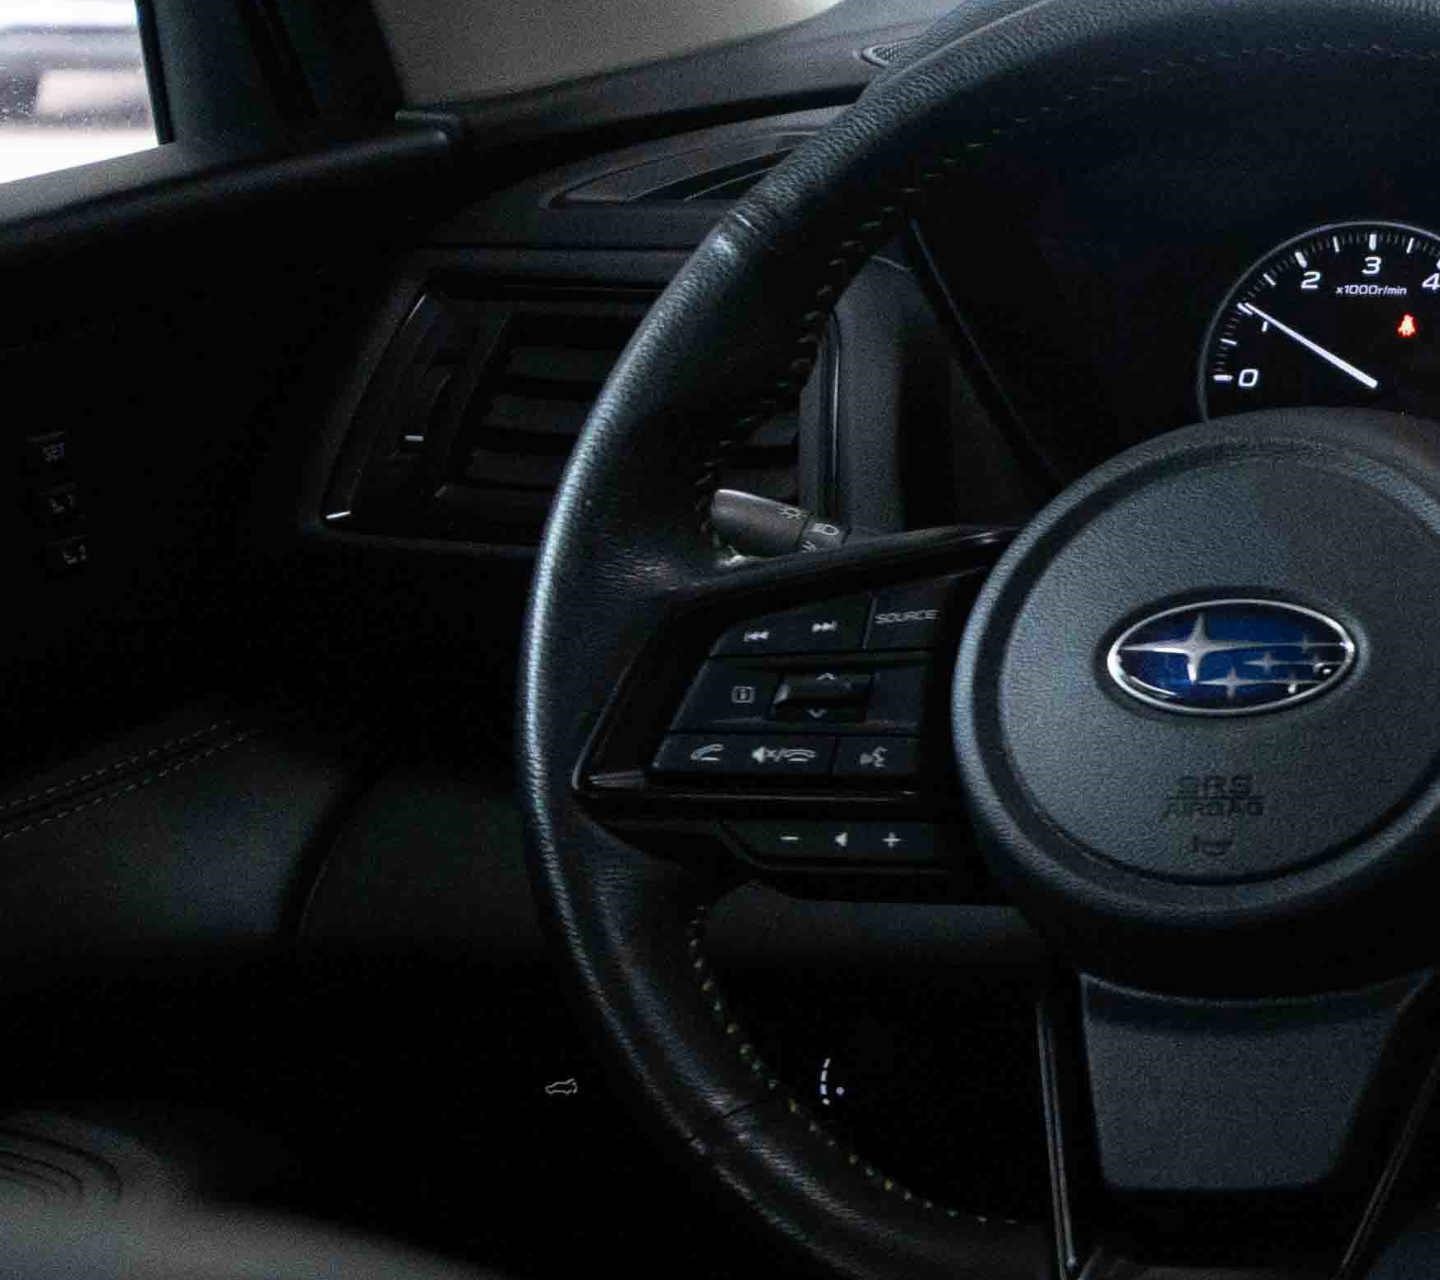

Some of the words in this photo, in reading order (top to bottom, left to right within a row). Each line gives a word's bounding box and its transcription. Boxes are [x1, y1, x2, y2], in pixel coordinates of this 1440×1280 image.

[1361, 256, 1382, 275] 3
[1300, 270, 1321, 290] 2
[1421, 272, 1440, 291] 4
[1335, 284, 1408, 296] x1000r/min
[1238, 368, 1259, 388] 0
[874, 609, 942, 625] SOURCE
